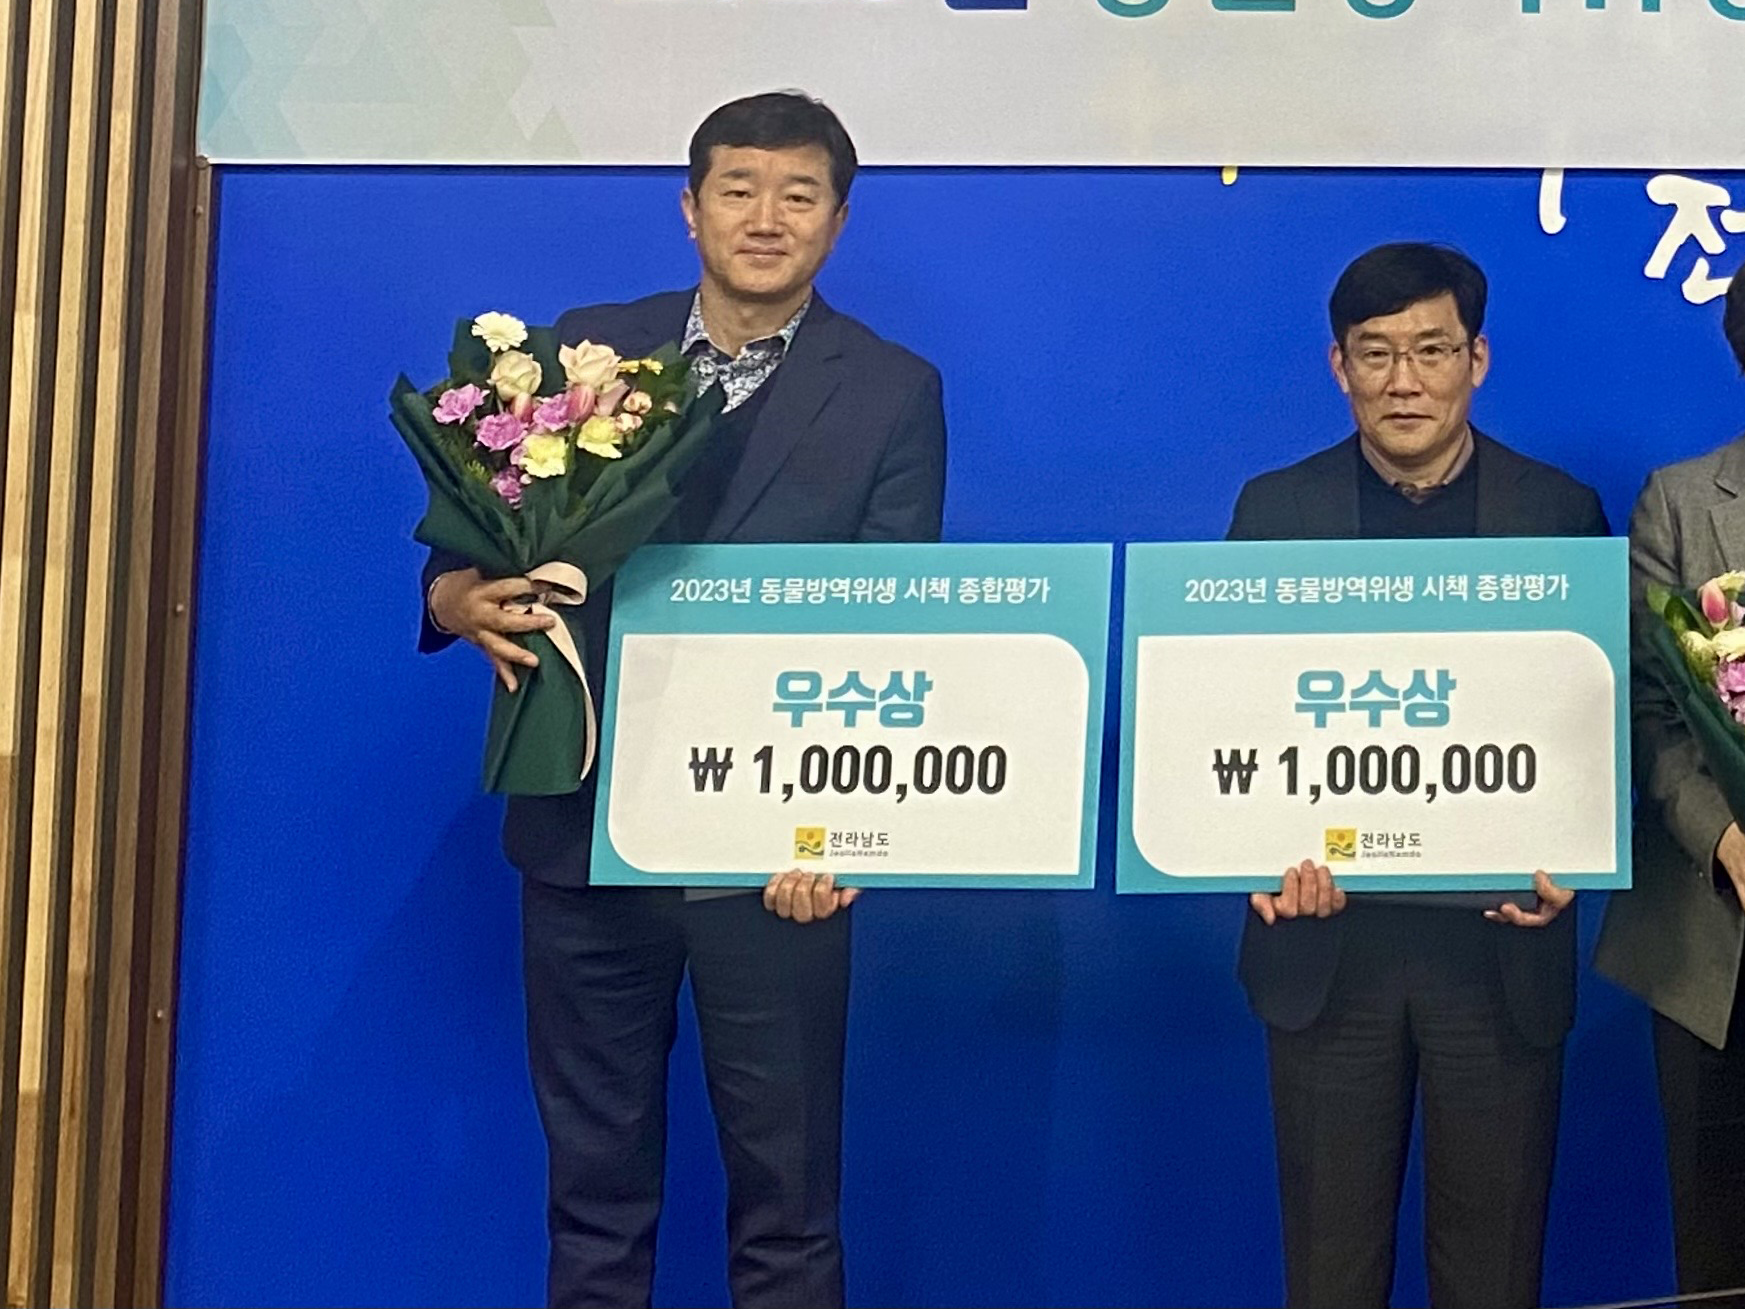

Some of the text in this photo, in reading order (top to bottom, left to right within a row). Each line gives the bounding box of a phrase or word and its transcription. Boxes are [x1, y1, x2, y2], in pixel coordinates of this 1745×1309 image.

[669, 576, 1051, 604] 2023년 동물방역위생 시책 종합평가
[1184, 574, 1569, 604] 2023년 동물방역위생 시책 종합평가
[772, 670, 933, 729] 우수상
[1294, 669, 1457, 728] 우수상
[752, 744, 1007, 803] 1,000,000
[1277, 744, 1537, 805] 1,000,000
[829, 832, 889, 848] 전라남도
[1360, 833, 1422, 849] 전라남도
